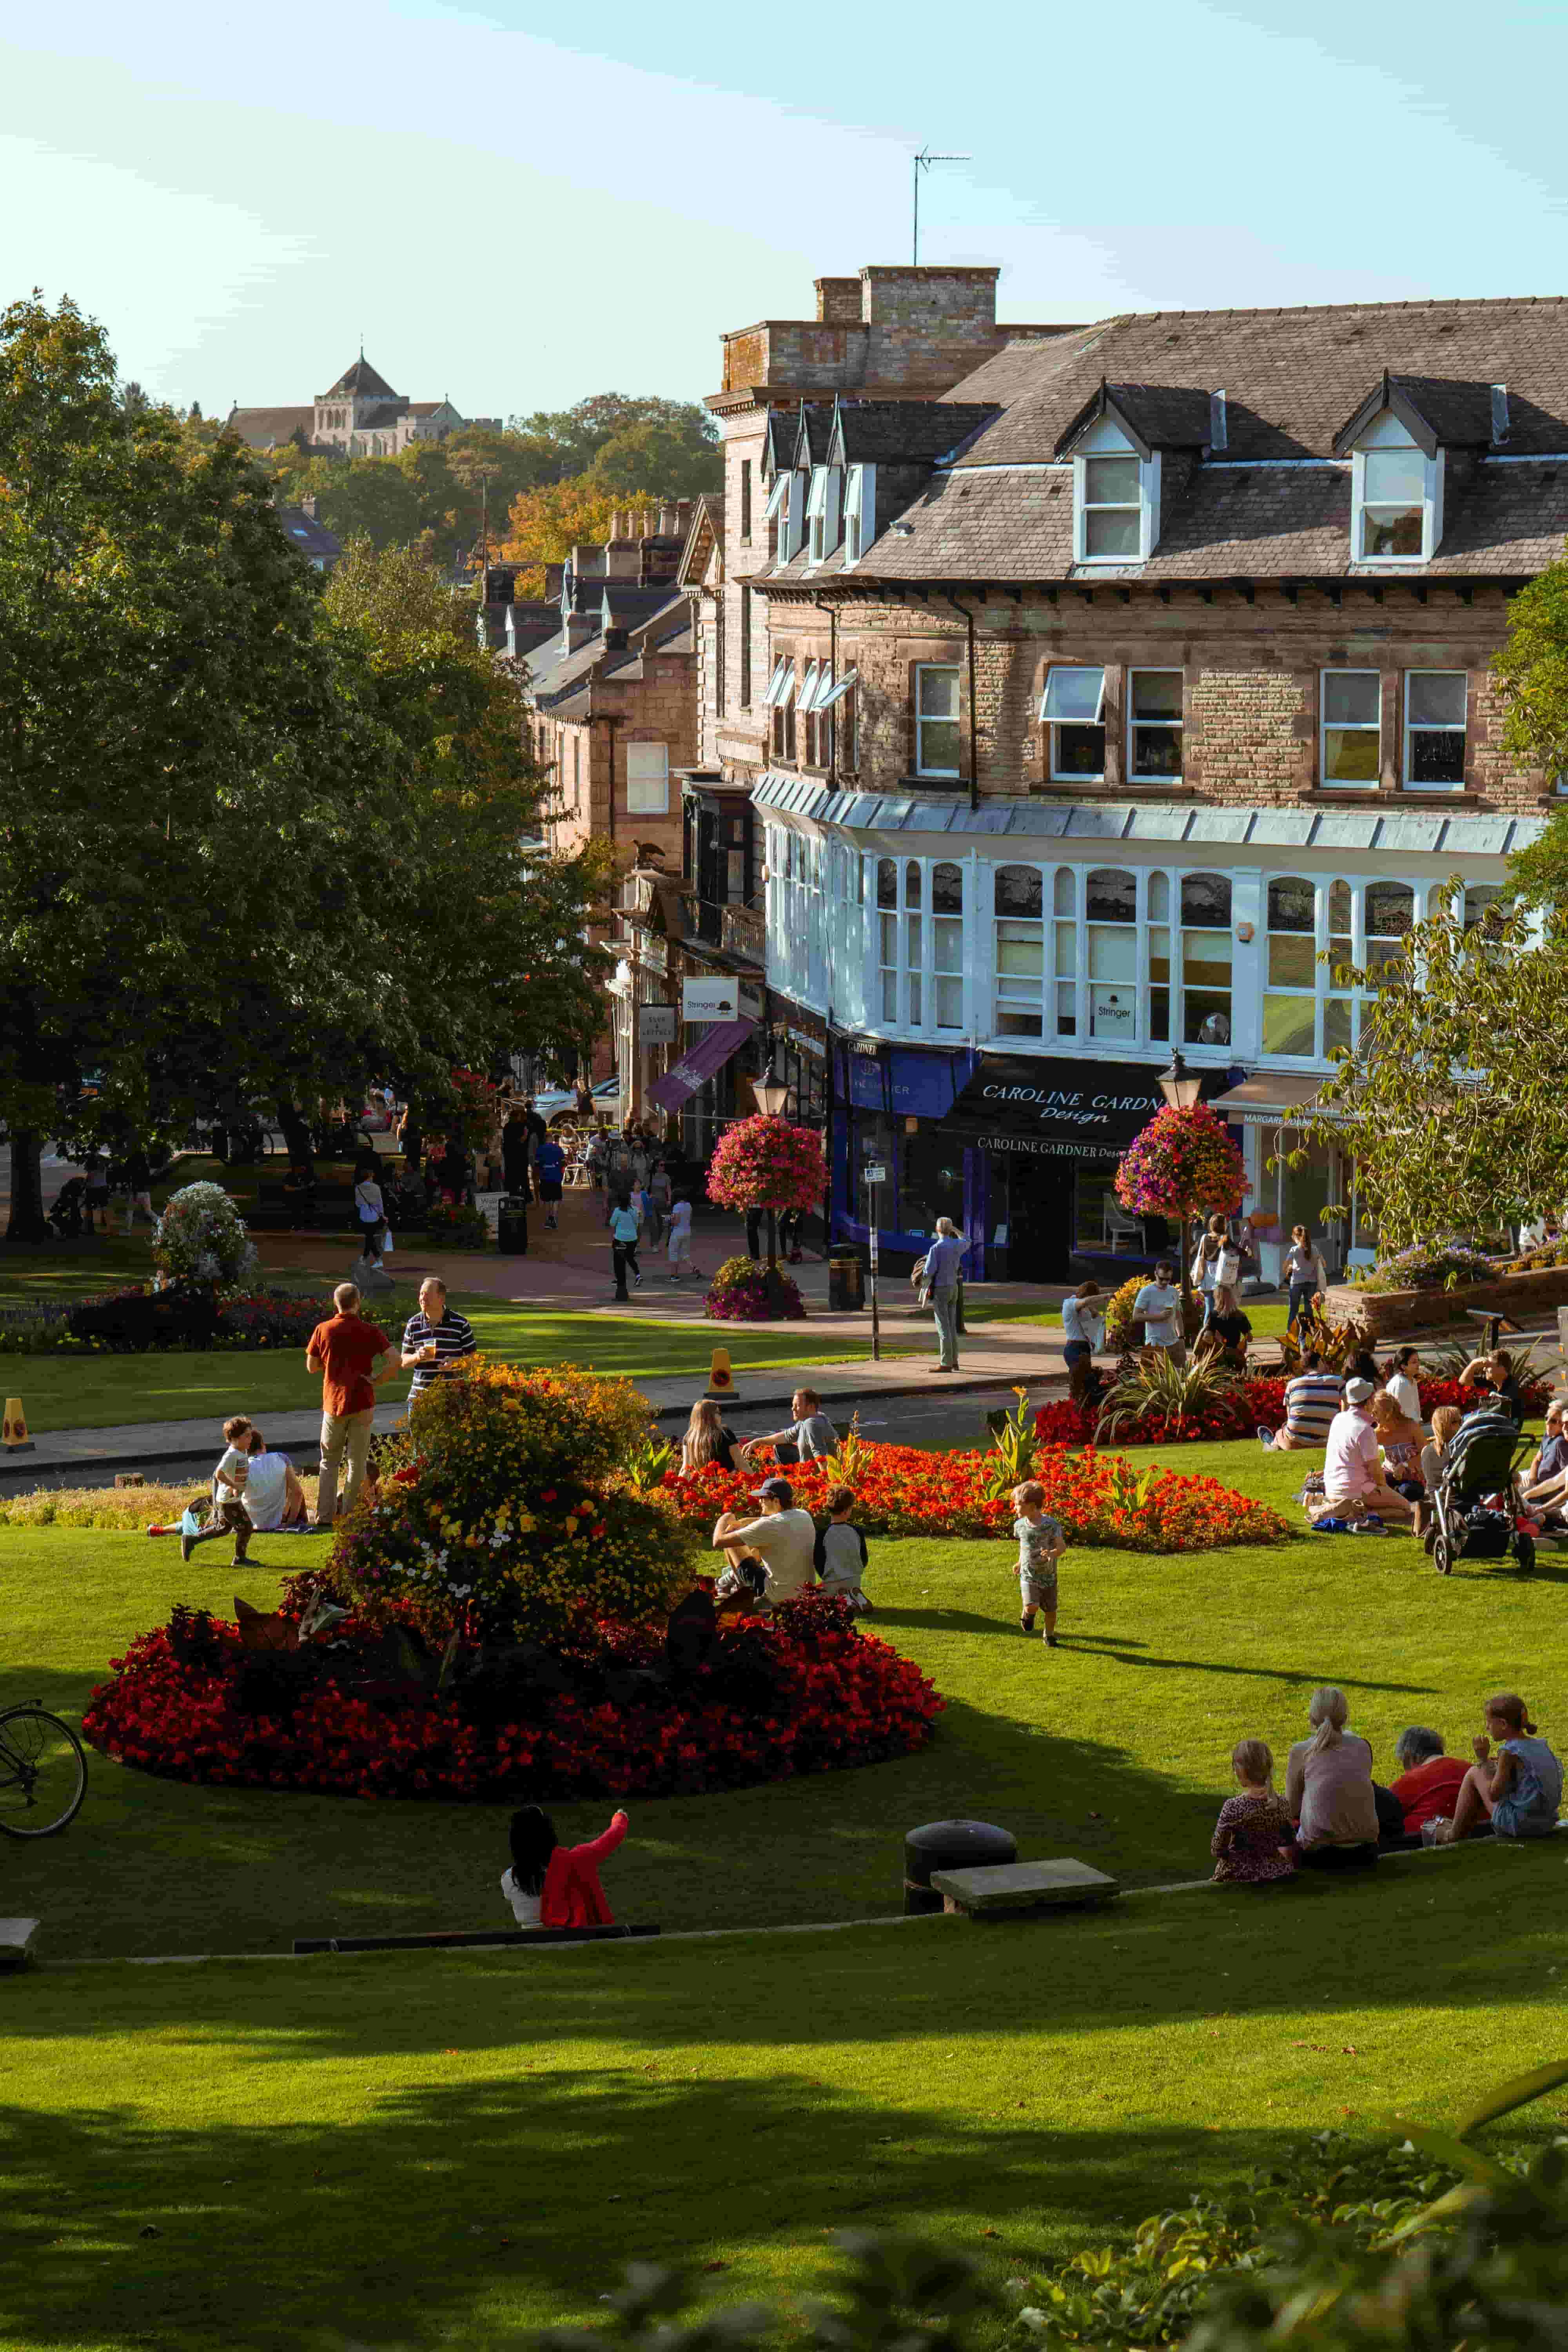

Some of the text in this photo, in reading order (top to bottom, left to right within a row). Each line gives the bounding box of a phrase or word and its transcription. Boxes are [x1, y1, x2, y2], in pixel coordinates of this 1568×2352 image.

[1097, 1006, 1131, 1019] Stringer
[848, 1041, 877, 1055] GARDNER
[982, 1085, 1166, 1111] CAROLINE GARDN
[1040, 1107, 1111, 1125] Design
[978, 1137, 1038, 1153] CAROLINE
[1040, 1143, 1096, 1158] GARDNER
